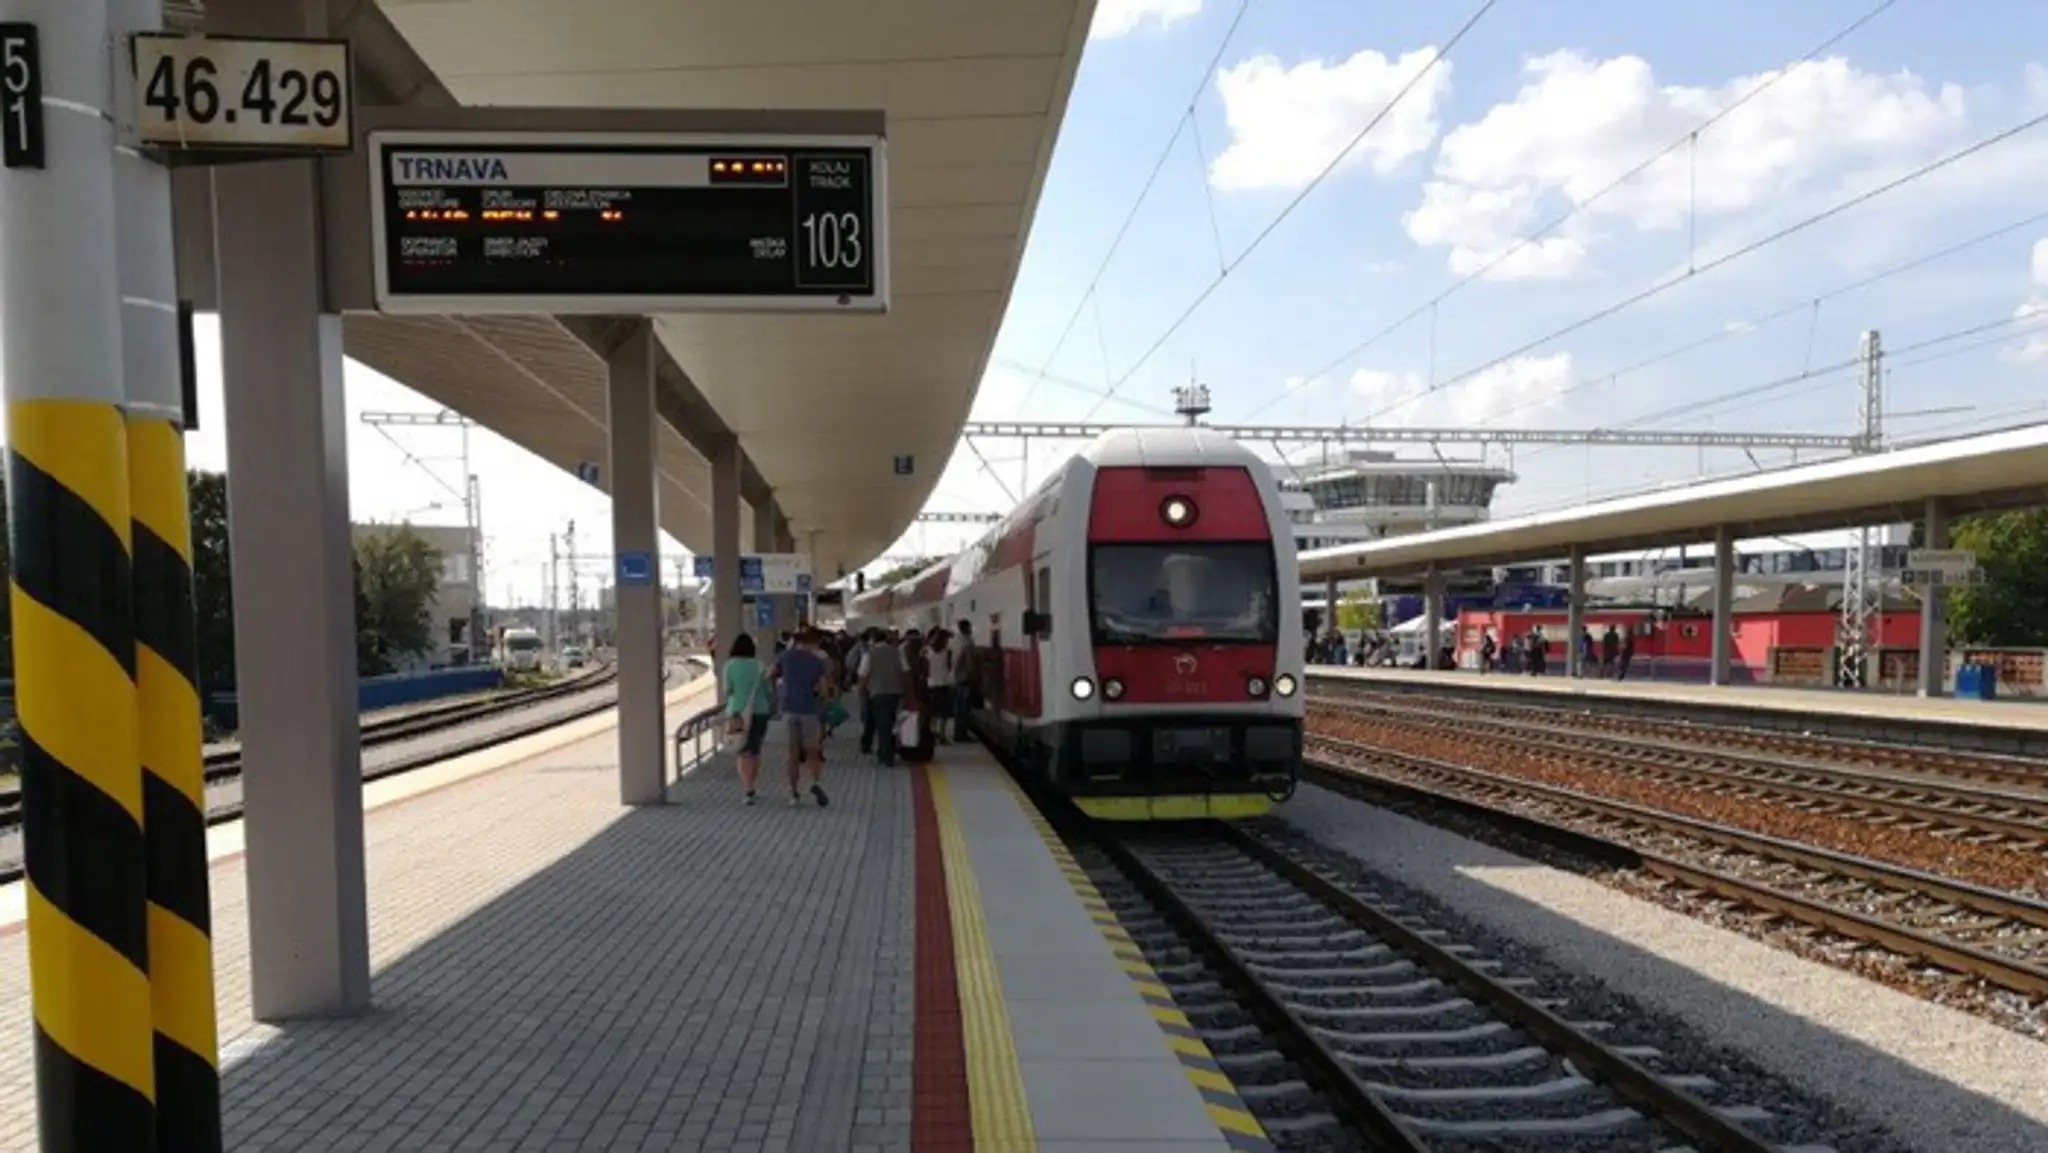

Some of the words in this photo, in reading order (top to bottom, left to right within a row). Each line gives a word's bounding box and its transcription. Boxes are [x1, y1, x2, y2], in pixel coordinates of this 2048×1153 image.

[145, 55, 341, 127] 46.429
[399, 158, 508, 181] TRNAVA
[801, 212, 862, 268] 103
